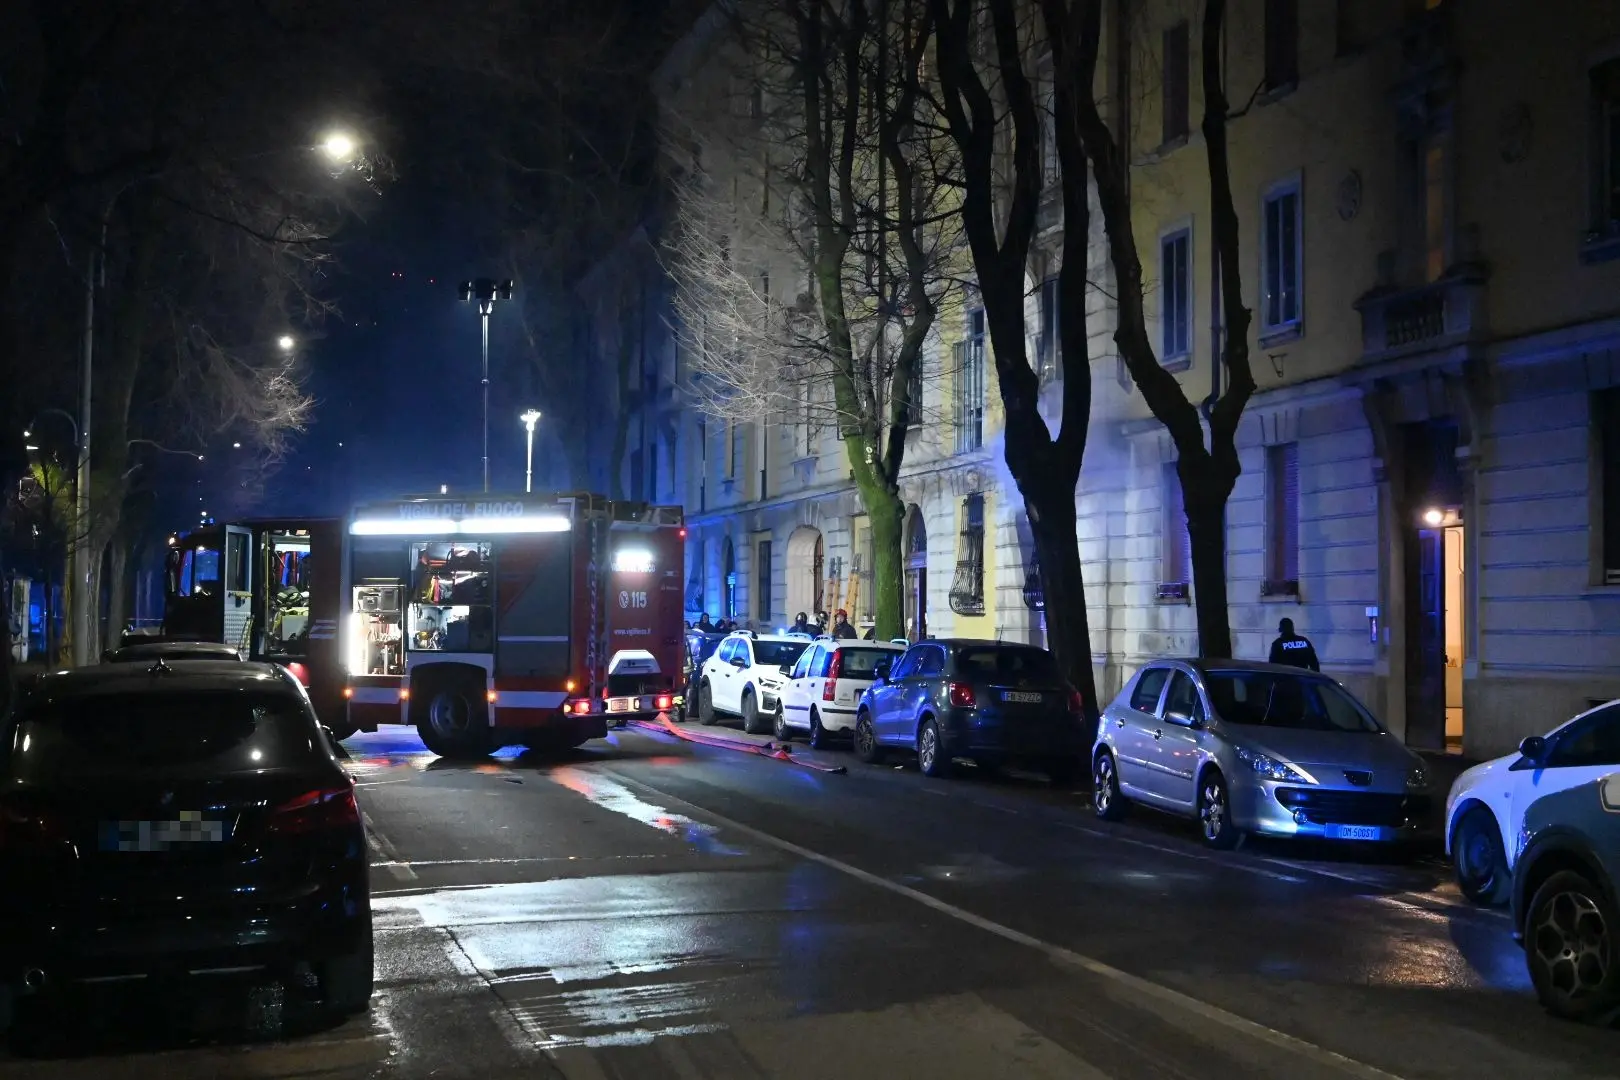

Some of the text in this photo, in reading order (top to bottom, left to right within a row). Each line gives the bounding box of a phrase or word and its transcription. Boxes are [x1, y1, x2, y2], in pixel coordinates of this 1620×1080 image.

[441, 503, 468, 518] DEL
[474, 502, 524, 518] FUOCO
[631, 591, 648, 608] 115
[1282, 640, 1308, 650] POLIZIA
